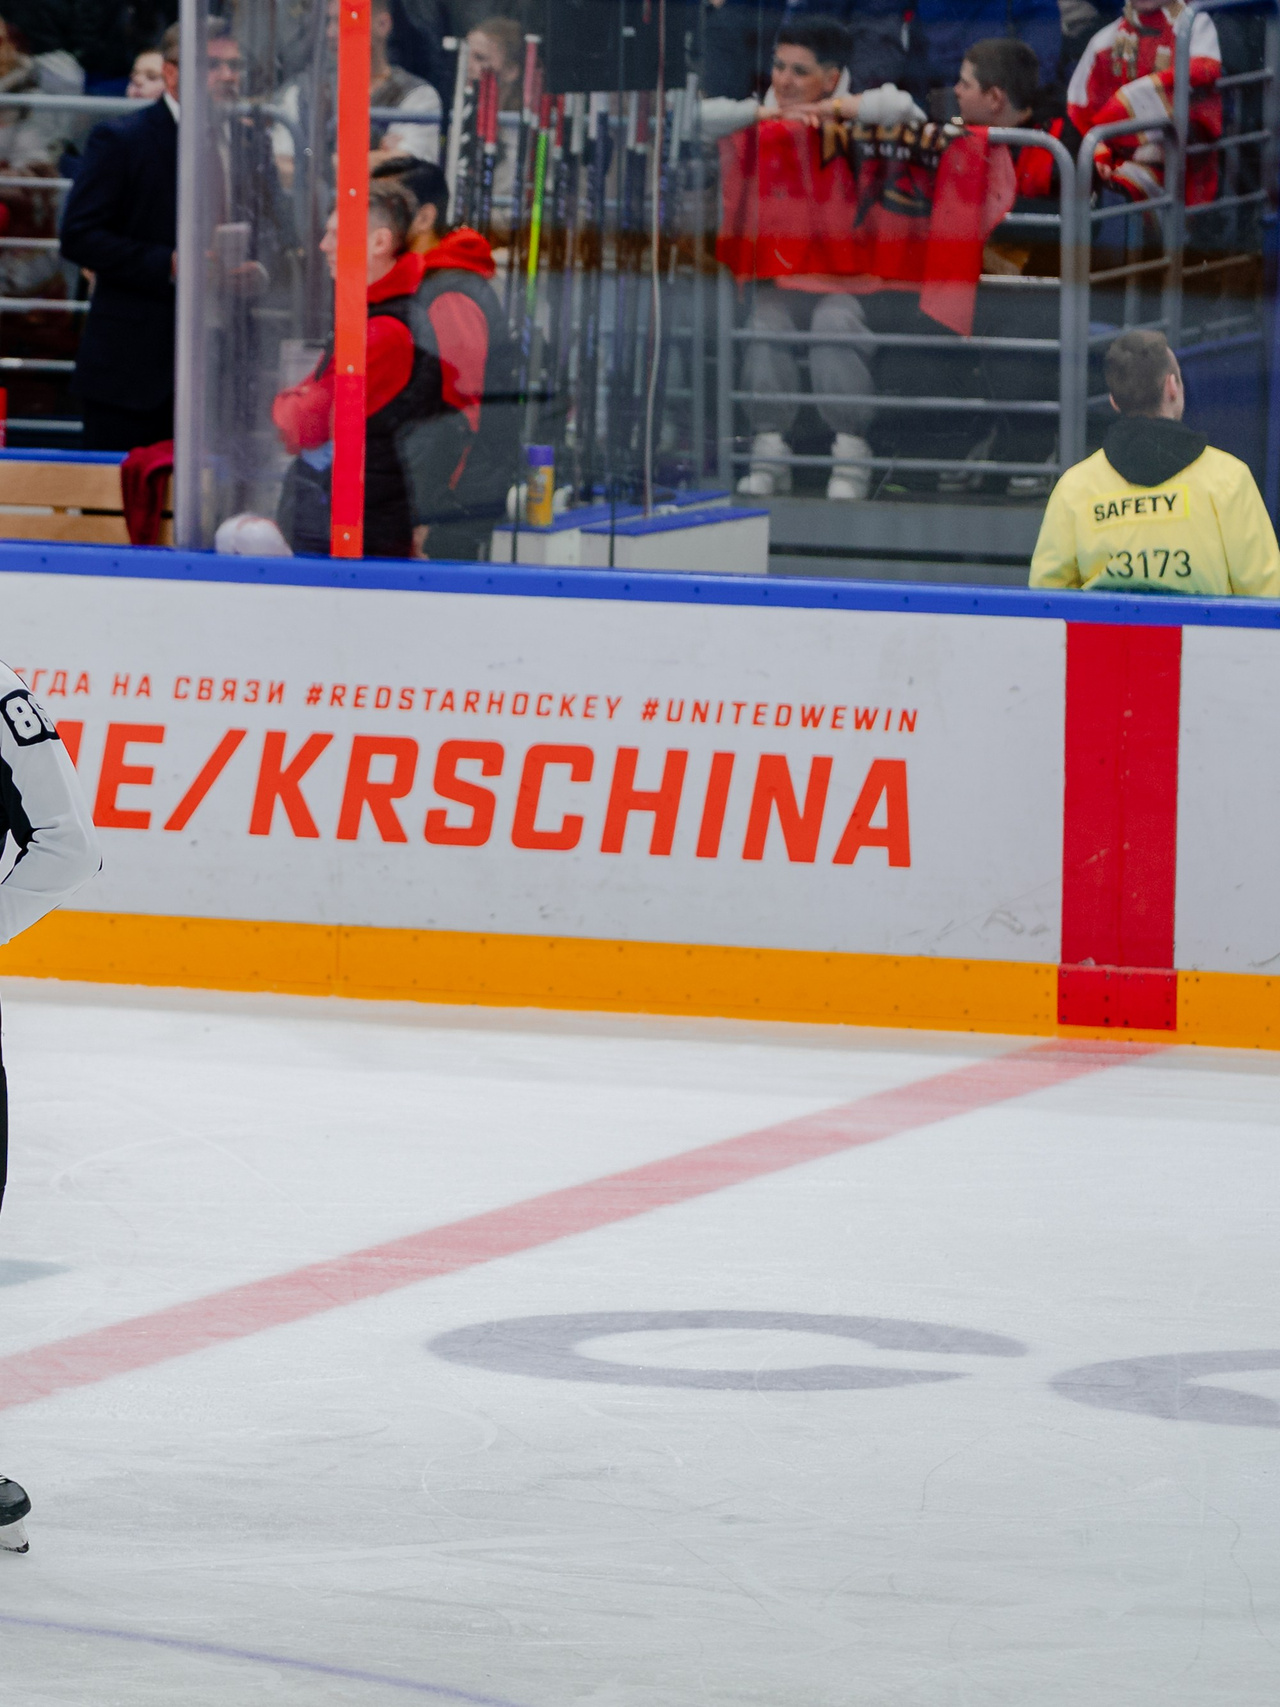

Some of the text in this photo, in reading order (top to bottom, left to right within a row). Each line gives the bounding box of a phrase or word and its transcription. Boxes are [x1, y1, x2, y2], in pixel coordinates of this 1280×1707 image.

[1094, 493, 1178, 521] SAFETY
[111, 673, 153, 698] НА
[172, 676, 286, 705] СВЯЗИ
[305, 682, 624, 720] #REDSTARHOCKEY
[641, 697, 920, 734] #UNITEDWEWIN
